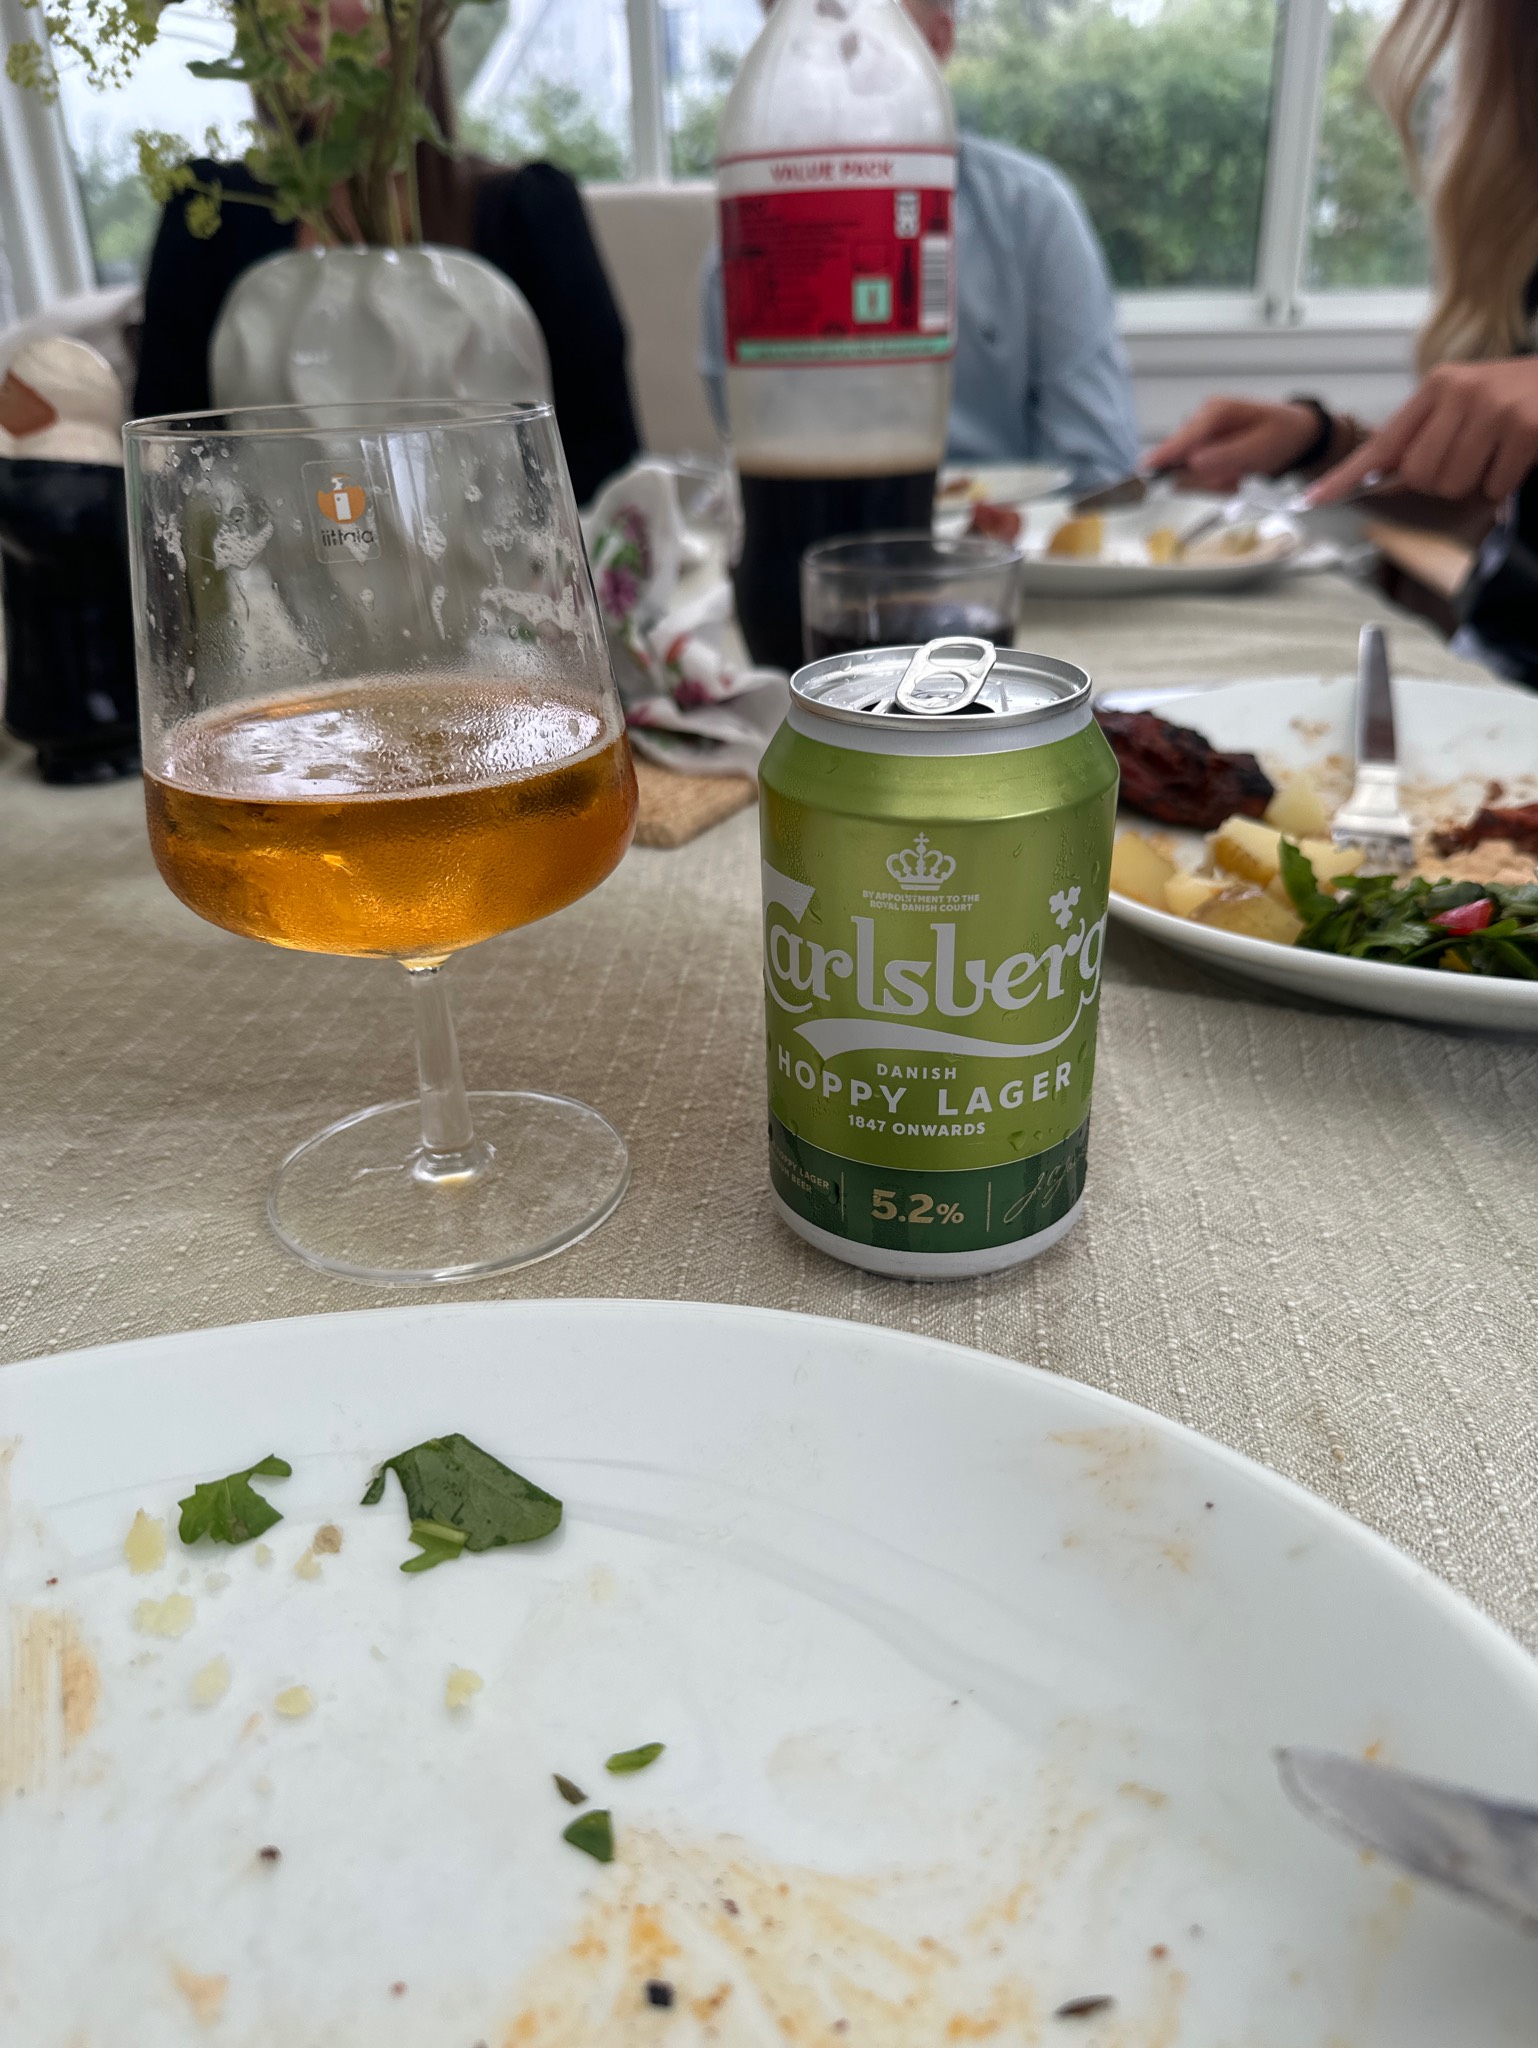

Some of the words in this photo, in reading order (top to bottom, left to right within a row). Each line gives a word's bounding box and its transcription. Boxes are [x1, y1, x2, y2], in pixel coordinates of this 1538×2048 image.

[770, 161, 832, 182] VALUE
[840, 158, 893, 178] PACK
[863, 890, 875, 899] BY
[875, 892, 944, 903] APPOINTMENT
[946, 895, 960, 903] TO
[961, 894, 980, 902] THE
[870, 899, 900, 910] ROYAL
[901, 903, 937, 912] DANISH
[940, 904, 973, 912] COURT
[763, 859, 1107, 1017] Carlsberg
[778, 1044, 907, 1113] HOPPY
[938, 1062, 1071, 1116] LAGER
[877, 1063, 957, 1080] DANISH
[848, 1114, 886, 1133] 1847
[892, 1122, 986, 1137] ONWARDS
[791, 1174, 813, 1194] BEER
[799, 1168, 830, 1190] LAGER
[871, 1188, 965, 1225] 5.2%
